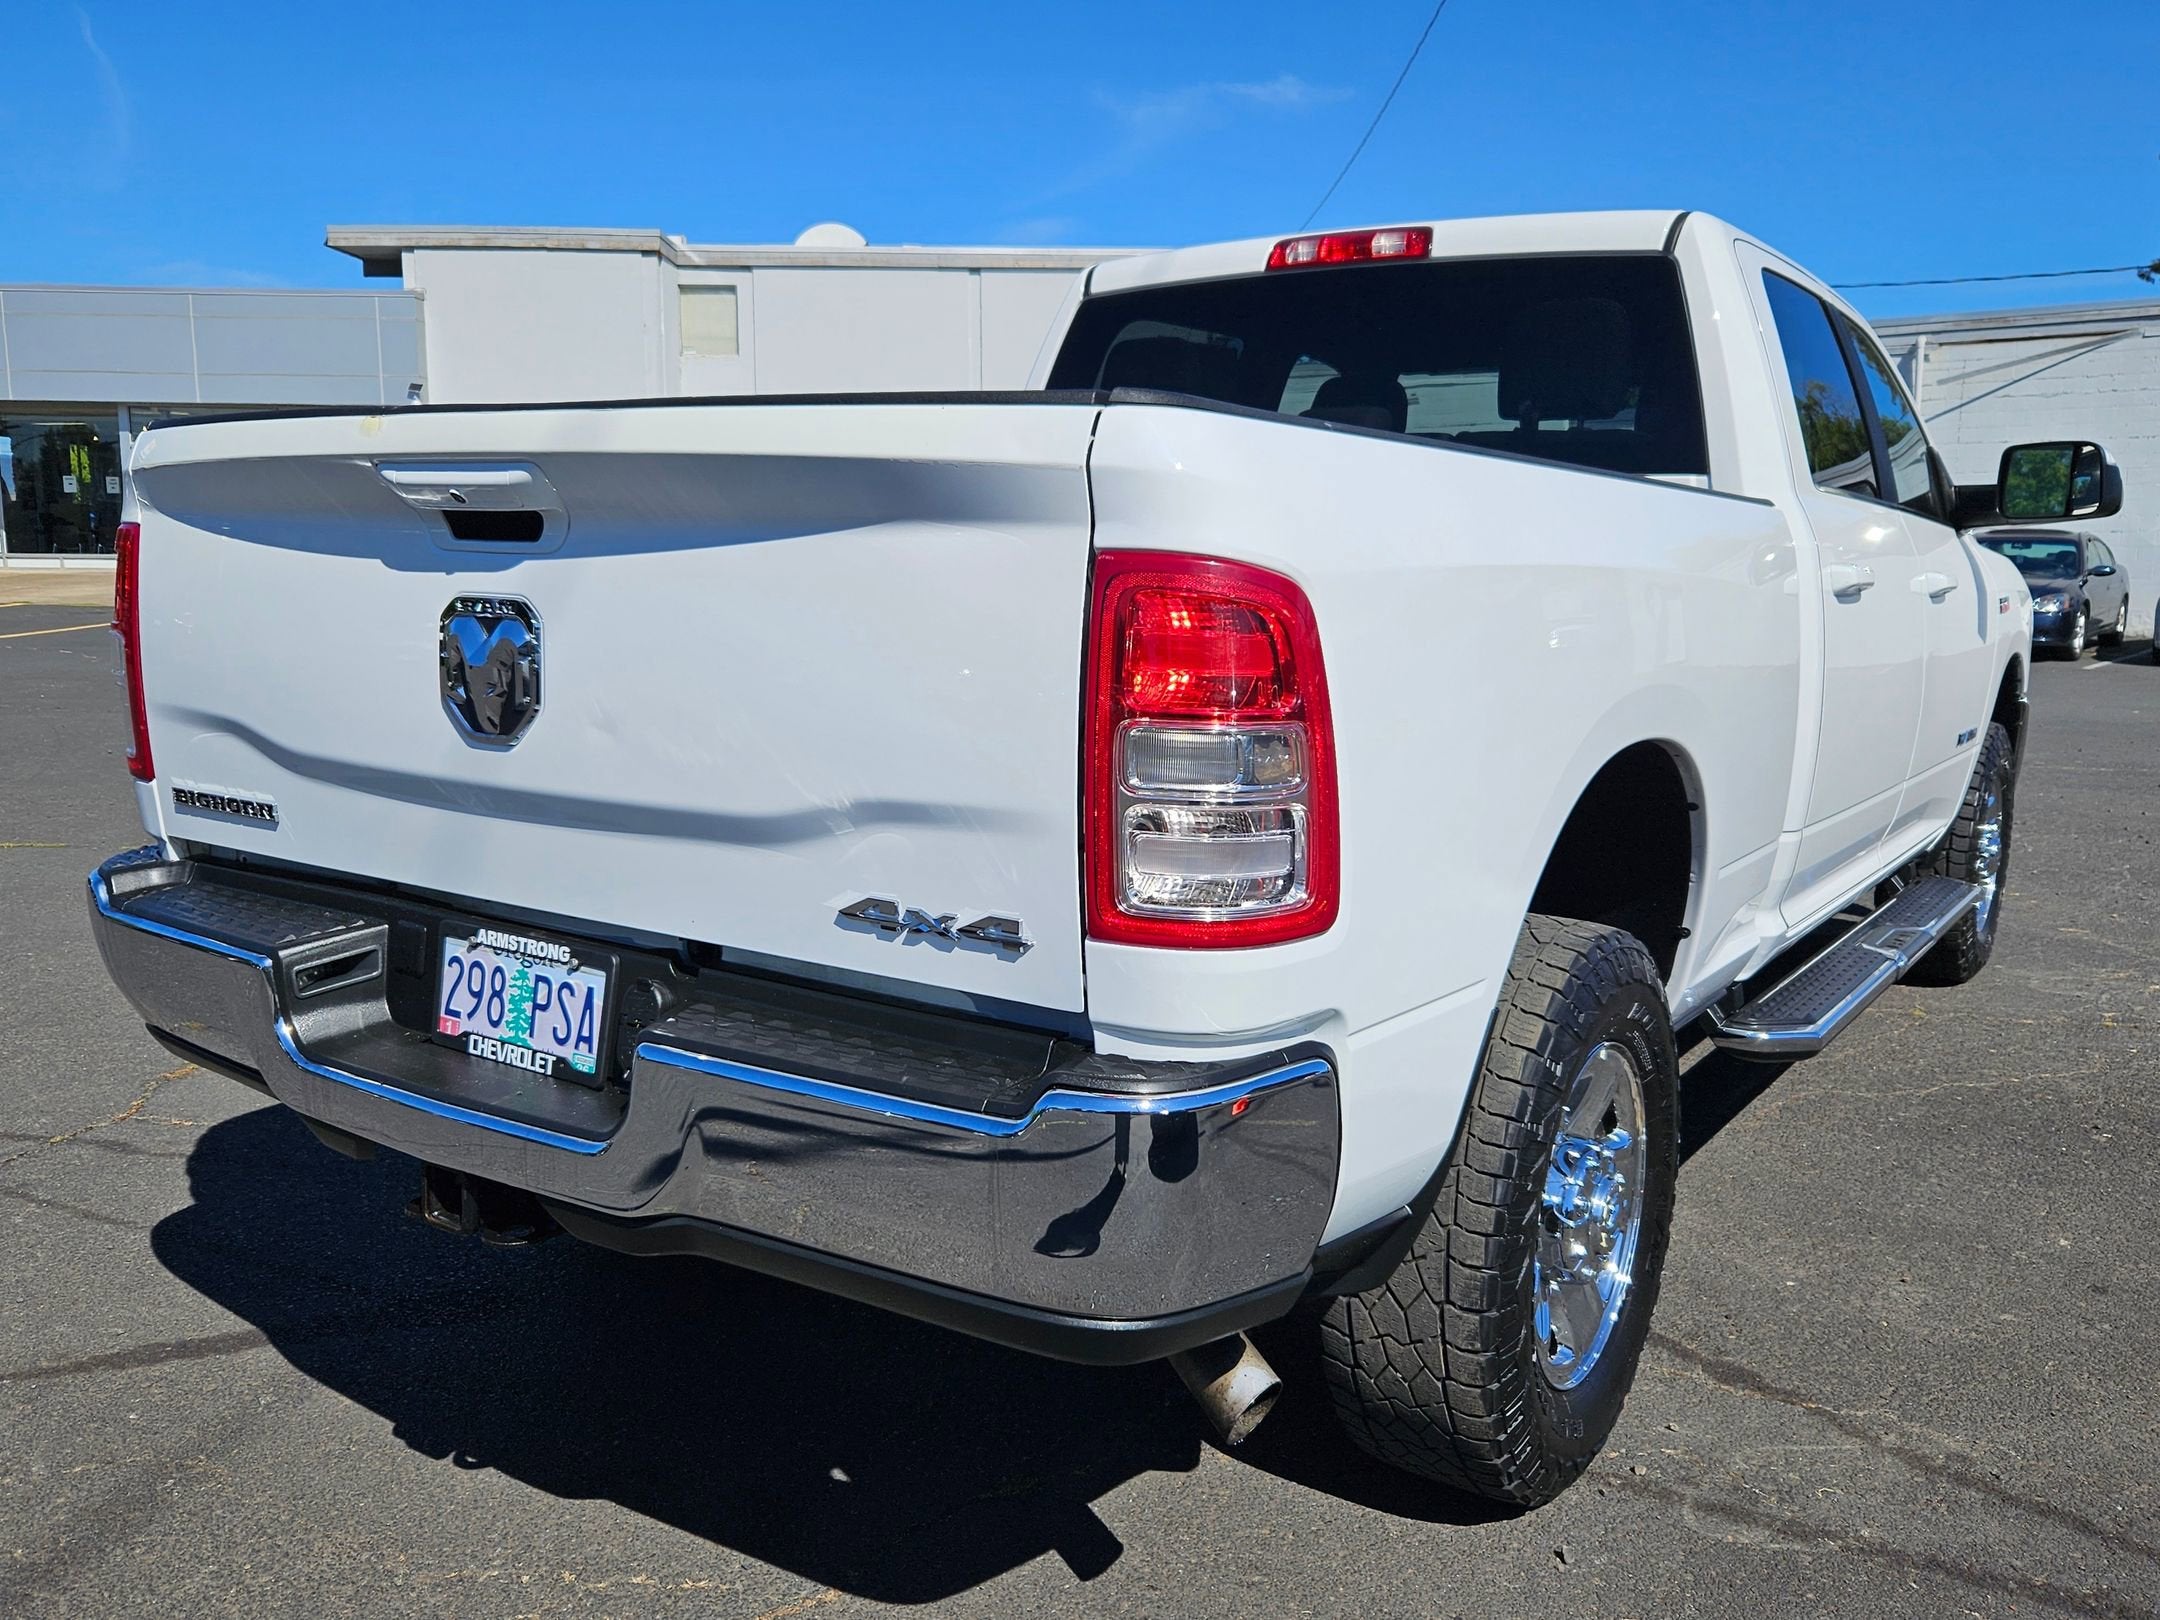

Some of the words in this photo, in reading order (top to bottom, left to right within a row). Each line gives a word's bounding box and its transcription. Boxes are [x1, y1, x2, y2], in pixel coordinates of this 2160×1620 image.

[476, 928, 571, 963] ARMSTRONG
[444, 955, 507, 1029] 298
[529, 973, 595, 1054] PSA
[467, 1034, 556, 1076] CHEVROLET
